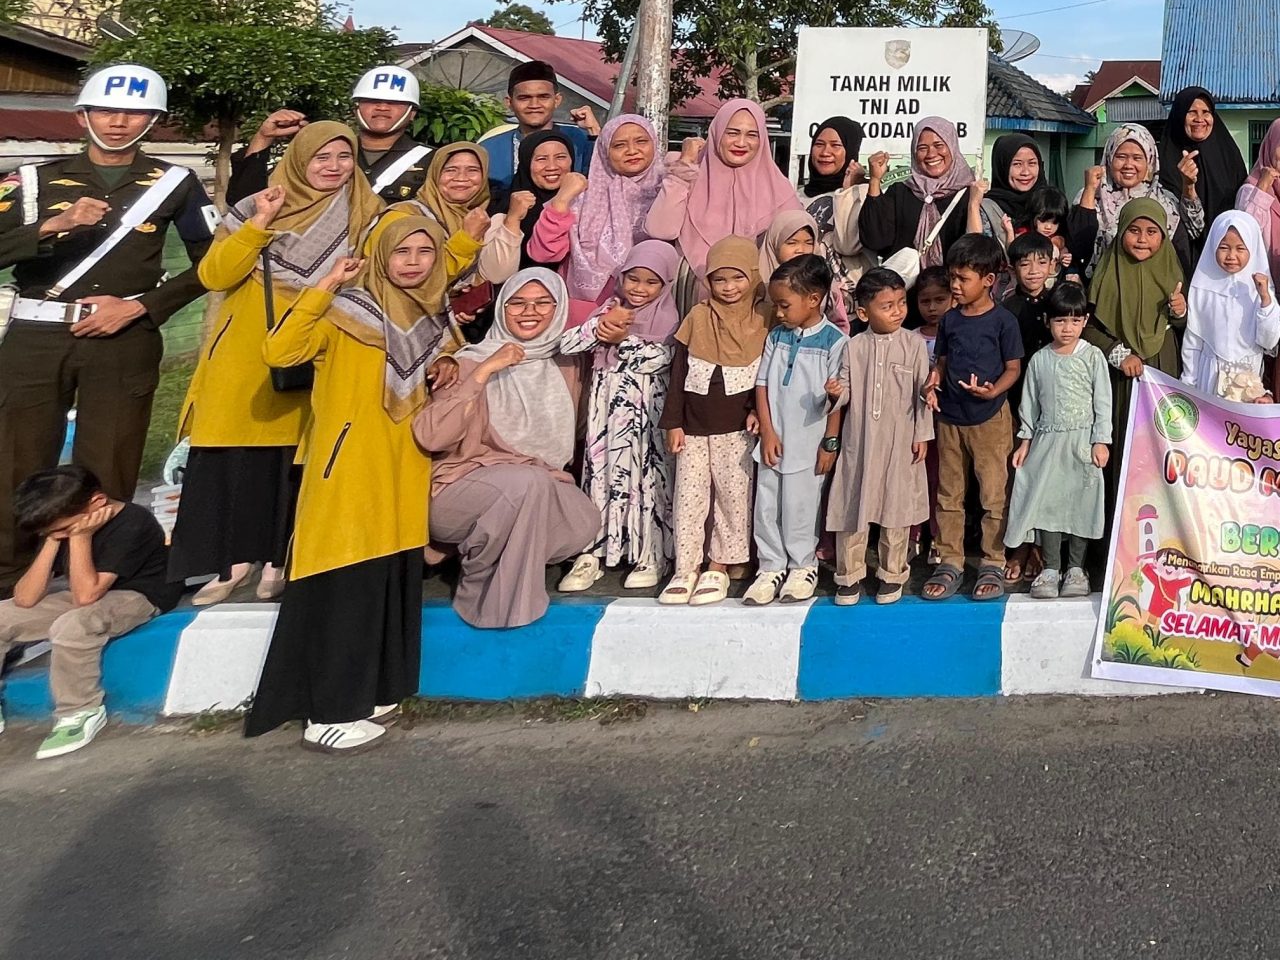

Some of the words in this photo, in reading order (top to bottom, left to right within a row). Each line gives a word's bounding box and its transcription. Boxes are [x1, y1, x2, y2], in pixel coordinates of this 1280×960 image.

[104, 76, 150, 99] PM
[372, 73, 407, 93] PM
[830, 75, 891, 92] TANAH
[897, 75, 952, 92] MILIK
[859, 98, 889, 115] TNI
[894, 98, 920, 115] AD
[1164, 449, 1255, 493] PAUD
[1232, 565, 1258, 578] Rasa
[1161, 612, 1256, 645] SELAMAT
